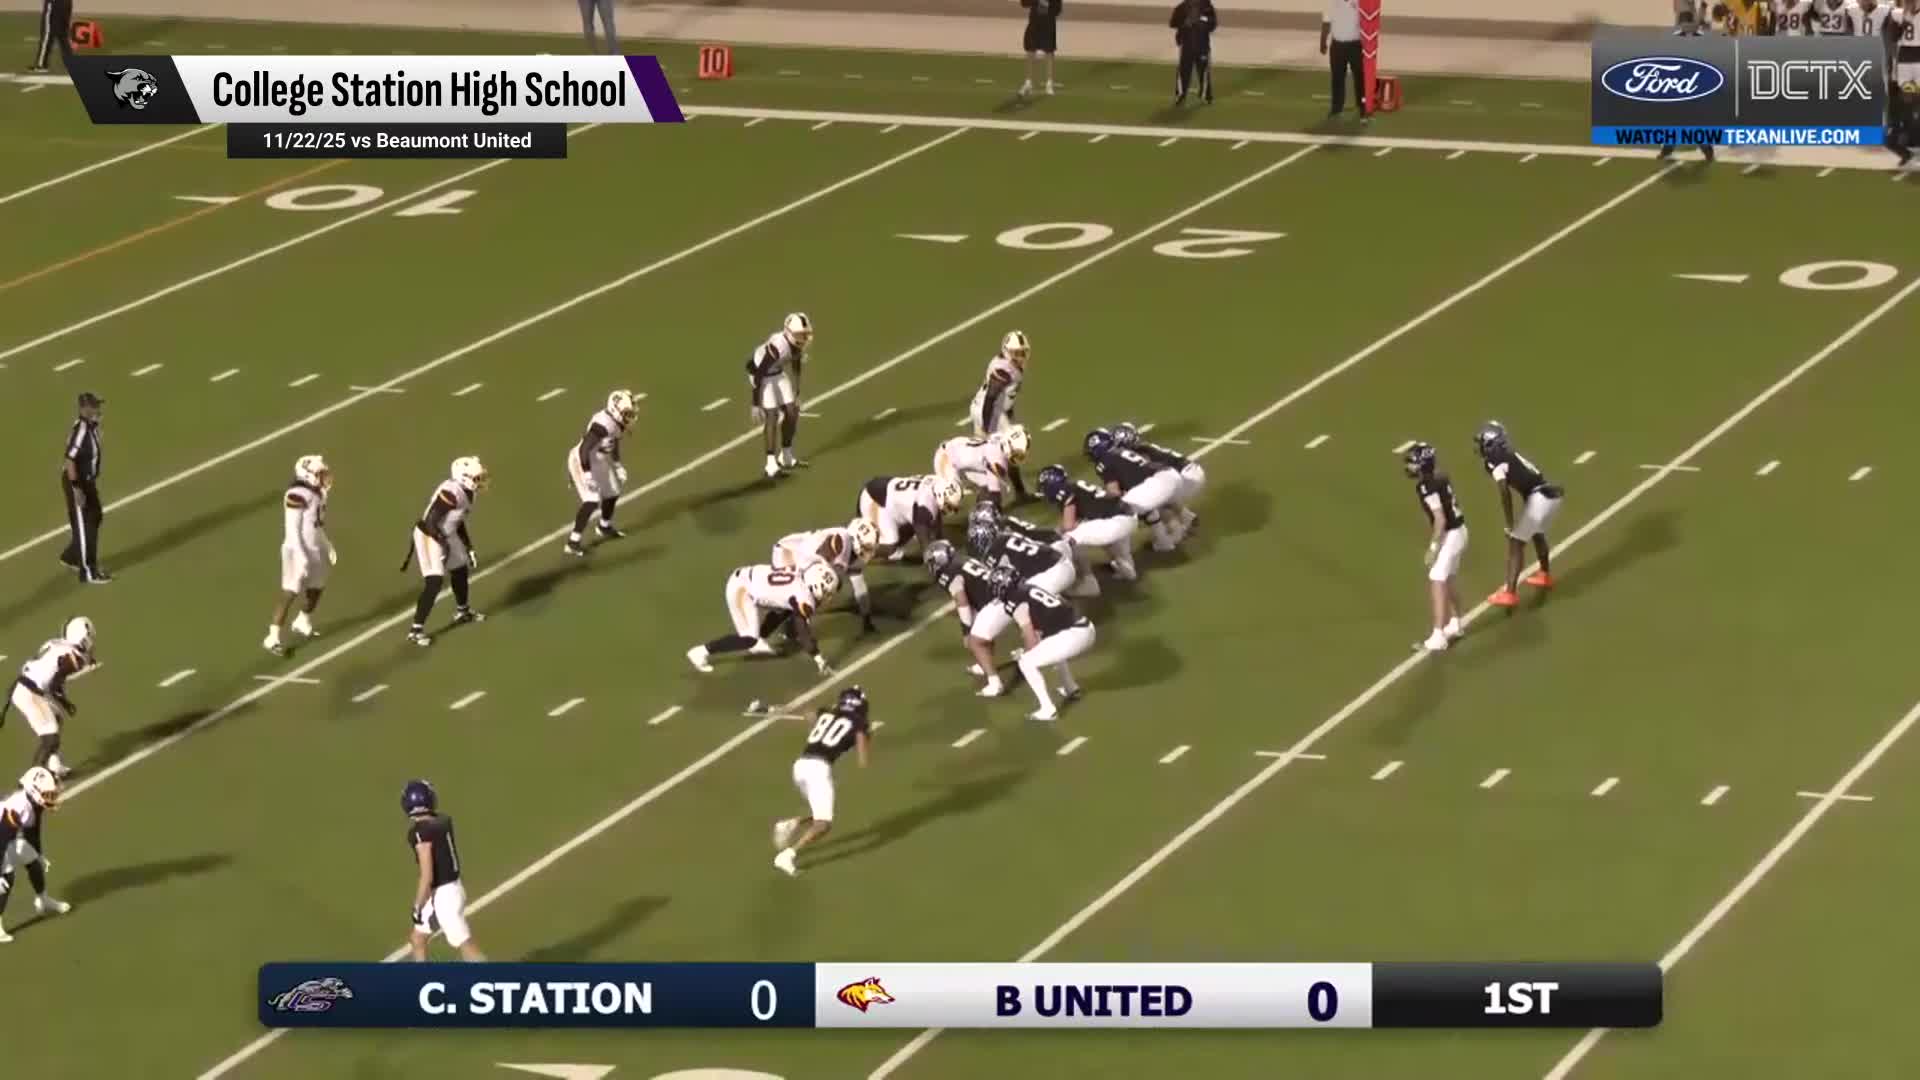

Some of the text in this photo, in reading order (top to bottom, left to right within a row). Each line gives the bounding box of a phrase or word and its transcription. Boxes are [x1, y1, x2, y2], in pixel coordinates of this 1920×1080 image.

[1779, 14, 1800, 31] 28
[1824, 13, 1842, 29] 23
[71, 22, 91, 44] G
[703, 47, 725, 73] 10
[807, 713, 852, 747] 80
